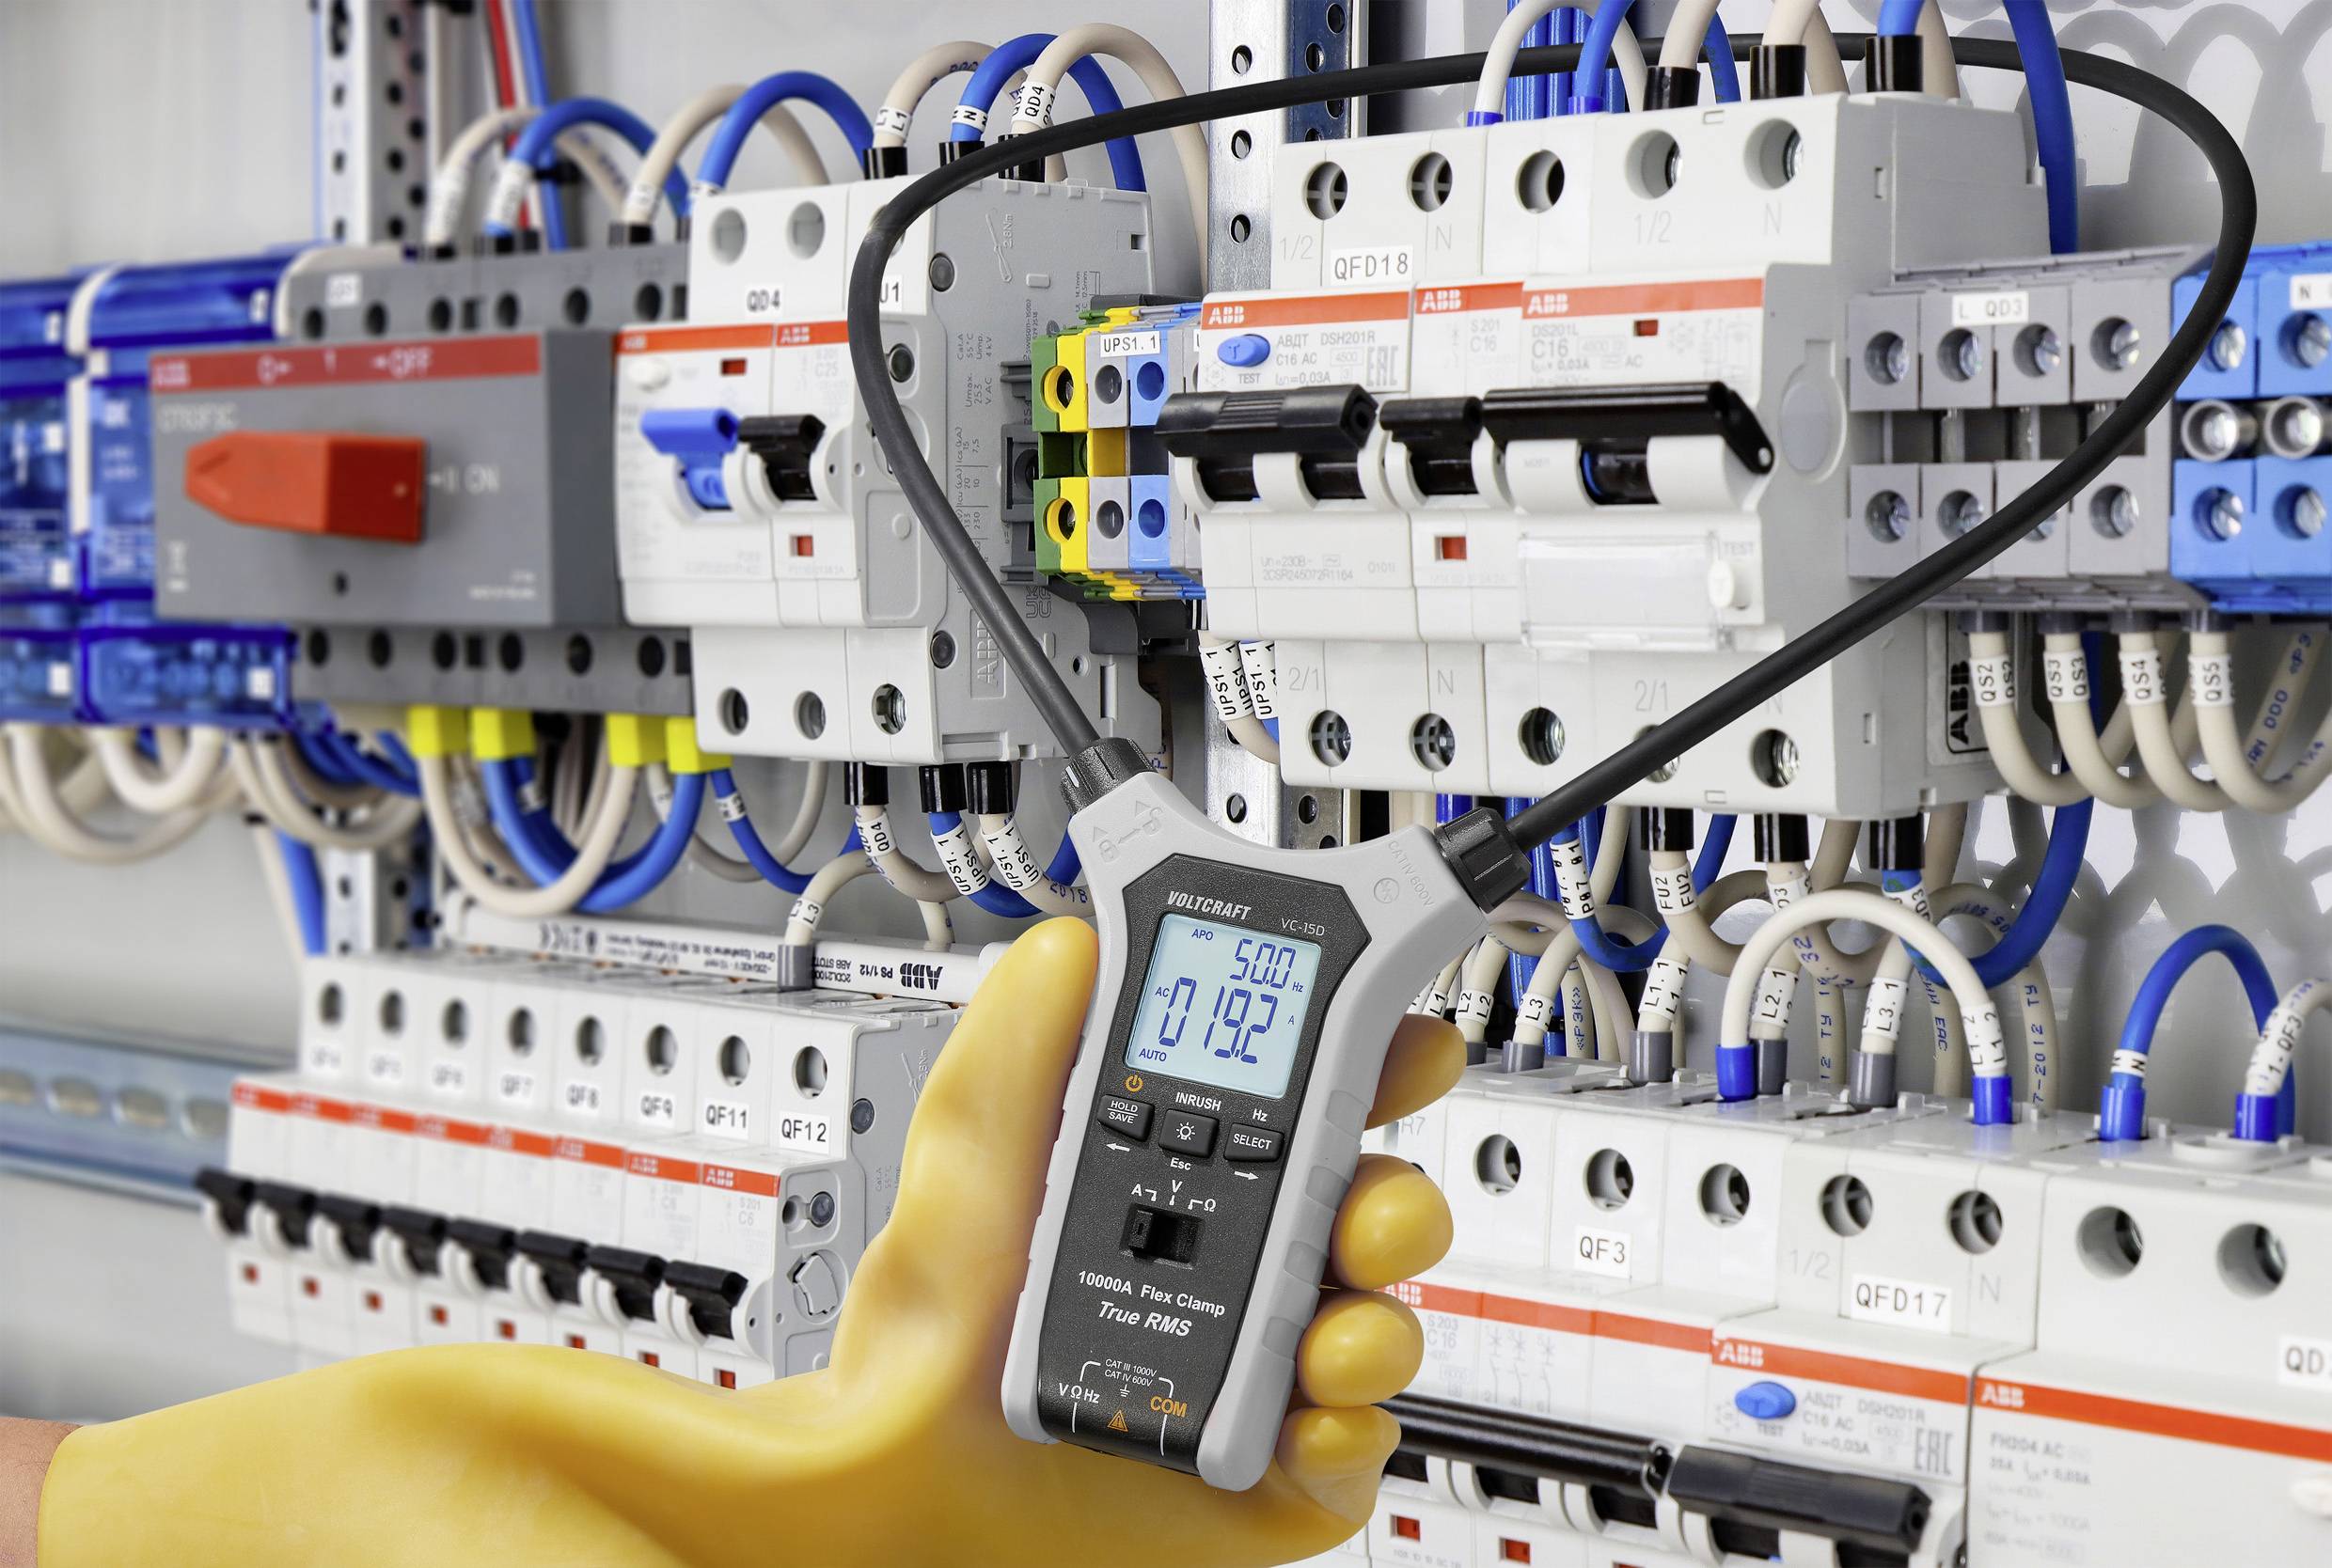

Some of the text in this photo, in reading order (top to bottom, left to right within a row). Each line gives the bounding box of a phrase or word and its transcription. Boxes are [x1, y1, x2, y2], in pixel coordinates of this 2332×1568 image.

[1024, 86, 1046, 118] QD4
[891, 112, 909, 132] L1
[963, 109, 978, 122] N
[1279, 234, 1315, 260] 1/2
[1333, 252, 1410, 281] QFD18
[1421, 290, 1462, 312] ABB
[1527, 293, 1568, 315] ABB
[1985, 297, 2023, 317] QD3
[1207, 306, 1245, 325] ABB
[1319, 330, 1376, 347] DSH201R
[1531, 338, 1569, 360] C16
[1275, 352, 1317, 367] C16 AC
[1237, 372, 1261, 384] TEST
[1288, 666, 1320, 692] 2/1
[1437, 669, 1456, 696] N
[1977, 663, 1996, 702] QS2
[2048, 659, 2064, 698] QS3
[2071, 656, 2088, 697] QS3
[2132, 659, 2152, 700] QS4
[2204, 661, 2222, 702] QS5
[1949, 660, 1970, 745] ABB
[871, 821, 890, 853] QD4
[1654, 876, 1674, 910] FU2
[1677, 872, 1694, 908] FU2
[803, 903, 820, 925] L3
[1166, 890, 1252, 921] VOLTCRAFT
[1190, 927, 1215, 942] APO
[1281, 917, 1326, 937] VC-15D
[859, 963, 944, 991] ABB PS 1/12
[1291, 980, 1305, 994] Hz
[1155, 985, 1170, 999] AC
[1287, 1014, 1296, 1027] A
[1429, 993, 1446, 1015] L1
[1457, 992, 1472, 1013] L2
[1476, 995, 1492, 1019] L2
[1525, 997, 1544, 1023] L3
[1138, 1047, 1168, 1063] AUTO
[640, 1095, 674, 1119] QF9
[1110, 1100, 1139, 1114] HOLD
[1174, 1090, 1222, 1112] INRUSH
[705, 1104, 748, 1129] QF11
[1108, 1110, 1135, 1125] SAVE
[1252, 1107, 1268, 1122] Hz
[781, 1118, 827, 1143] QF12
[1233, 1133, 1272, 1151] SELECT
[1170, 1156, 1191, 1171] Esc
[705, 1167, 735, 1189] ABB
[1130, 1179, 1217, 1213] A V Ω
[1579, 1235, 1626, 1264] QF3
[1078, 1270, 1226, 1318] 10000A Flex Clamp
[1855, 1282, 1947, 1318] QFD17
[1097, 1300, 1193, 1338] True RMS
[1719, 1341, 1765, 1369] ABB
[2285, 1343, 2326, 1375] QD
[1104, 1369, 1154, 1388] CAT IV 600V
[1105, 1358, 1158, 1378] CAT III 1000V
[1058, 1382, 1101, 1405] V Ω Hz
[1980, 1382, 2025, 1408] ABB
[1149, 1394, 1188, 1419] COM
[1757, 1422, 1785, 1438] TEST
